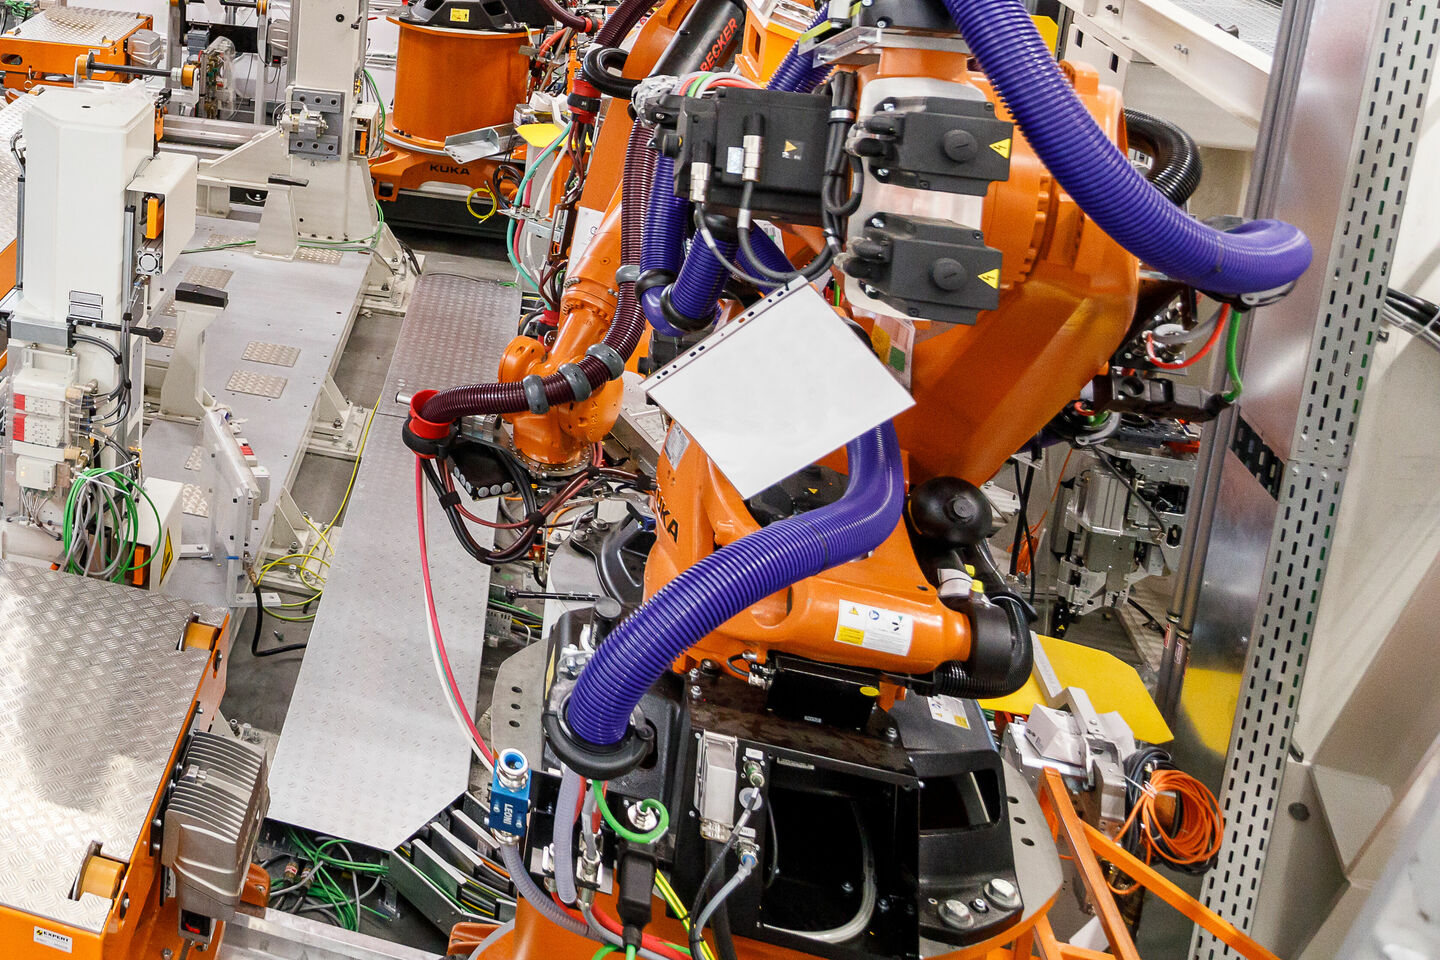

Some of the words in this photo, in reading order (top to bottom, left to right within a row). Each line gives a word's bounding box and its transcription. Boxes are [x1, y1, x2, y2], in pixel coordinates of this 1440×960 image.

[699, 17, 738, 72] BECKER
[429, 163, 471, 177] KUKA
[503, 803, 513, 826] LEONI
